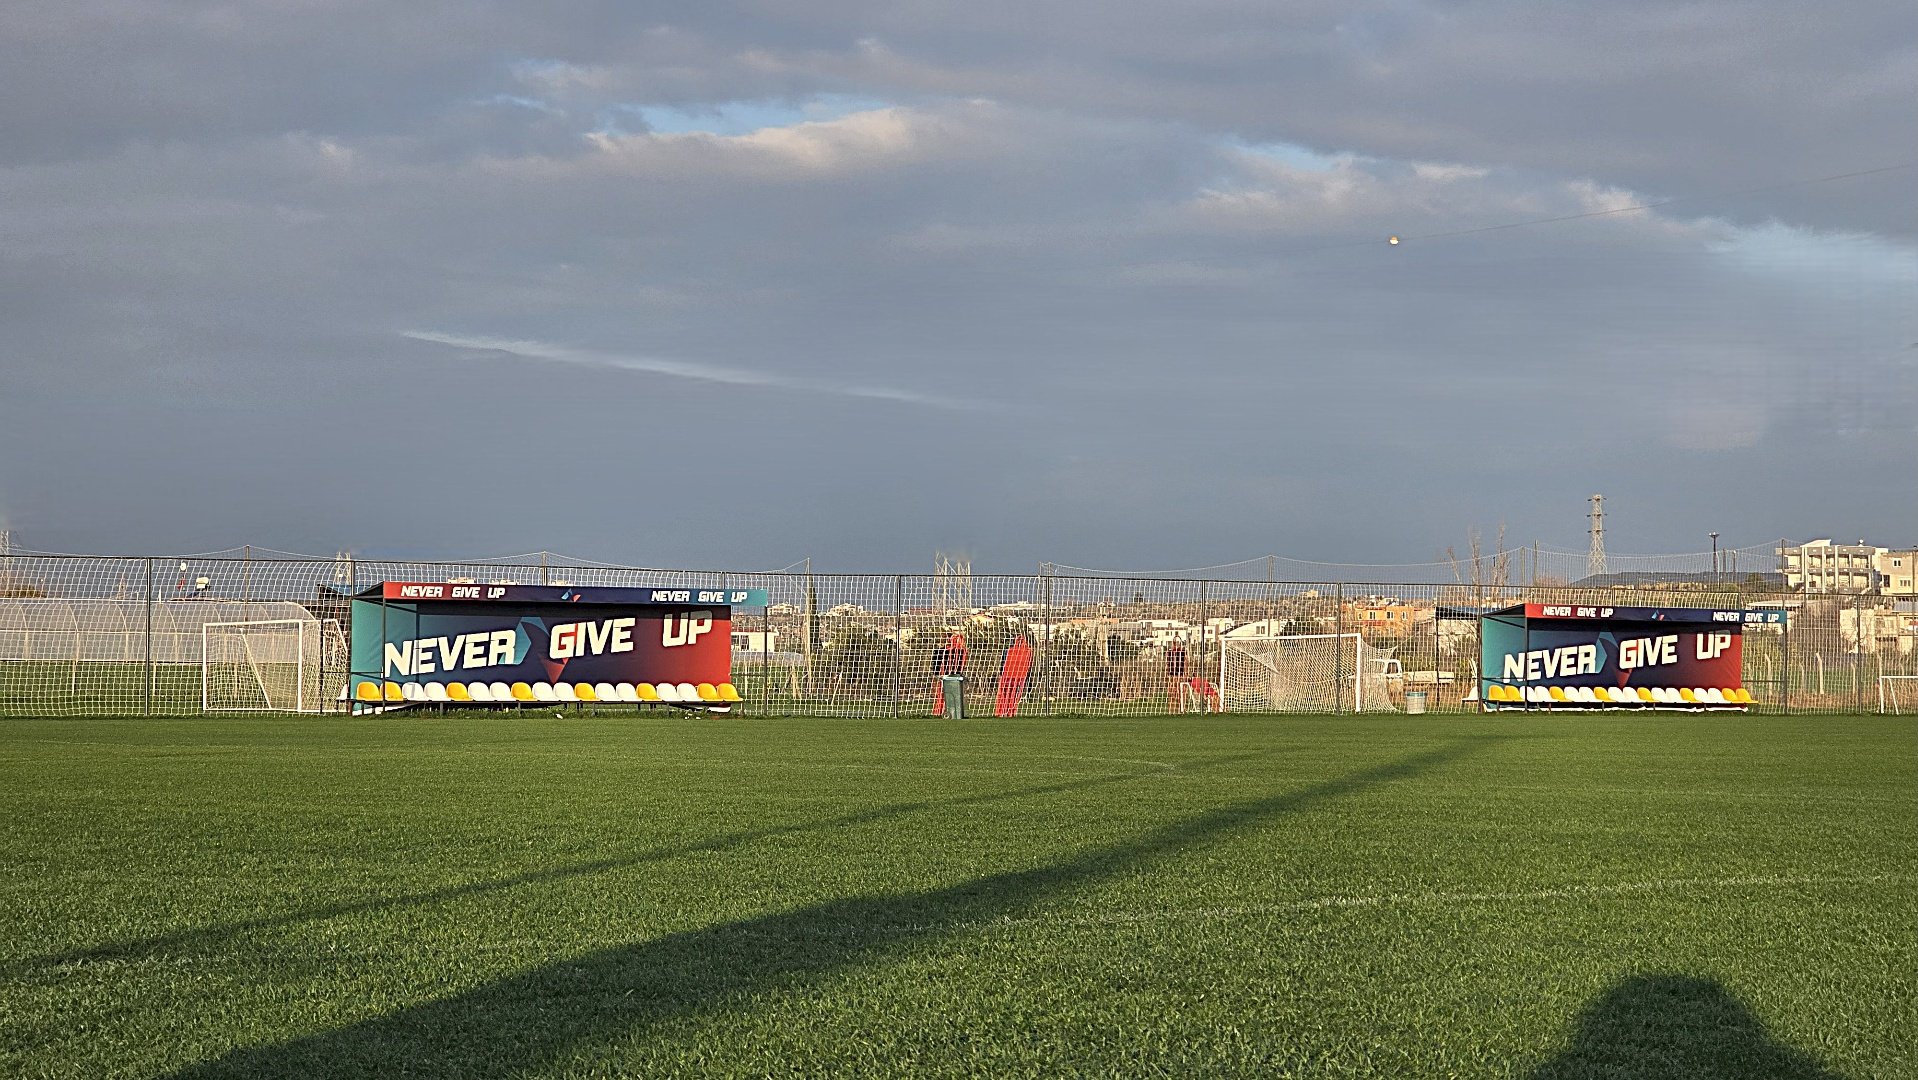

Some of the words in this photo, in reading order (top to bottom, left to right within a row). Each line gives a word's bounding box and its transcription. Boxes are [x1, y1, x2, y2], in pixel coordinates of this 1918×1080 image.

[401, 585, 443, 598] NEVER
[452, 586, 480, 598] GIVE
[487, 587, 506, 599] UP
[651, 590, 690, 602] NEVER
[697, 591, 724, 603] GIVE
[730, 592, 748, 603] UP
[1542, 605, 1572, 616] NEVER
[1577, 607, 1597, 617] GIVE
[1601, 607, 1614, 618] UP
[1712, 611, 1740, 622] NEVER
[1744, 612, 1764, 622] GIVE
[1767, 613, 1780, 623] UP
[381, 629, 516, 679] NEVER
[549, 617, 636, 660] GIVE
[662, 610, 713, 648] UP
[1503, 644, 1597, 684] NEVER
[1619, 634, 1678, 670] GIVE
[1696, 629, 1732, 660] UP
